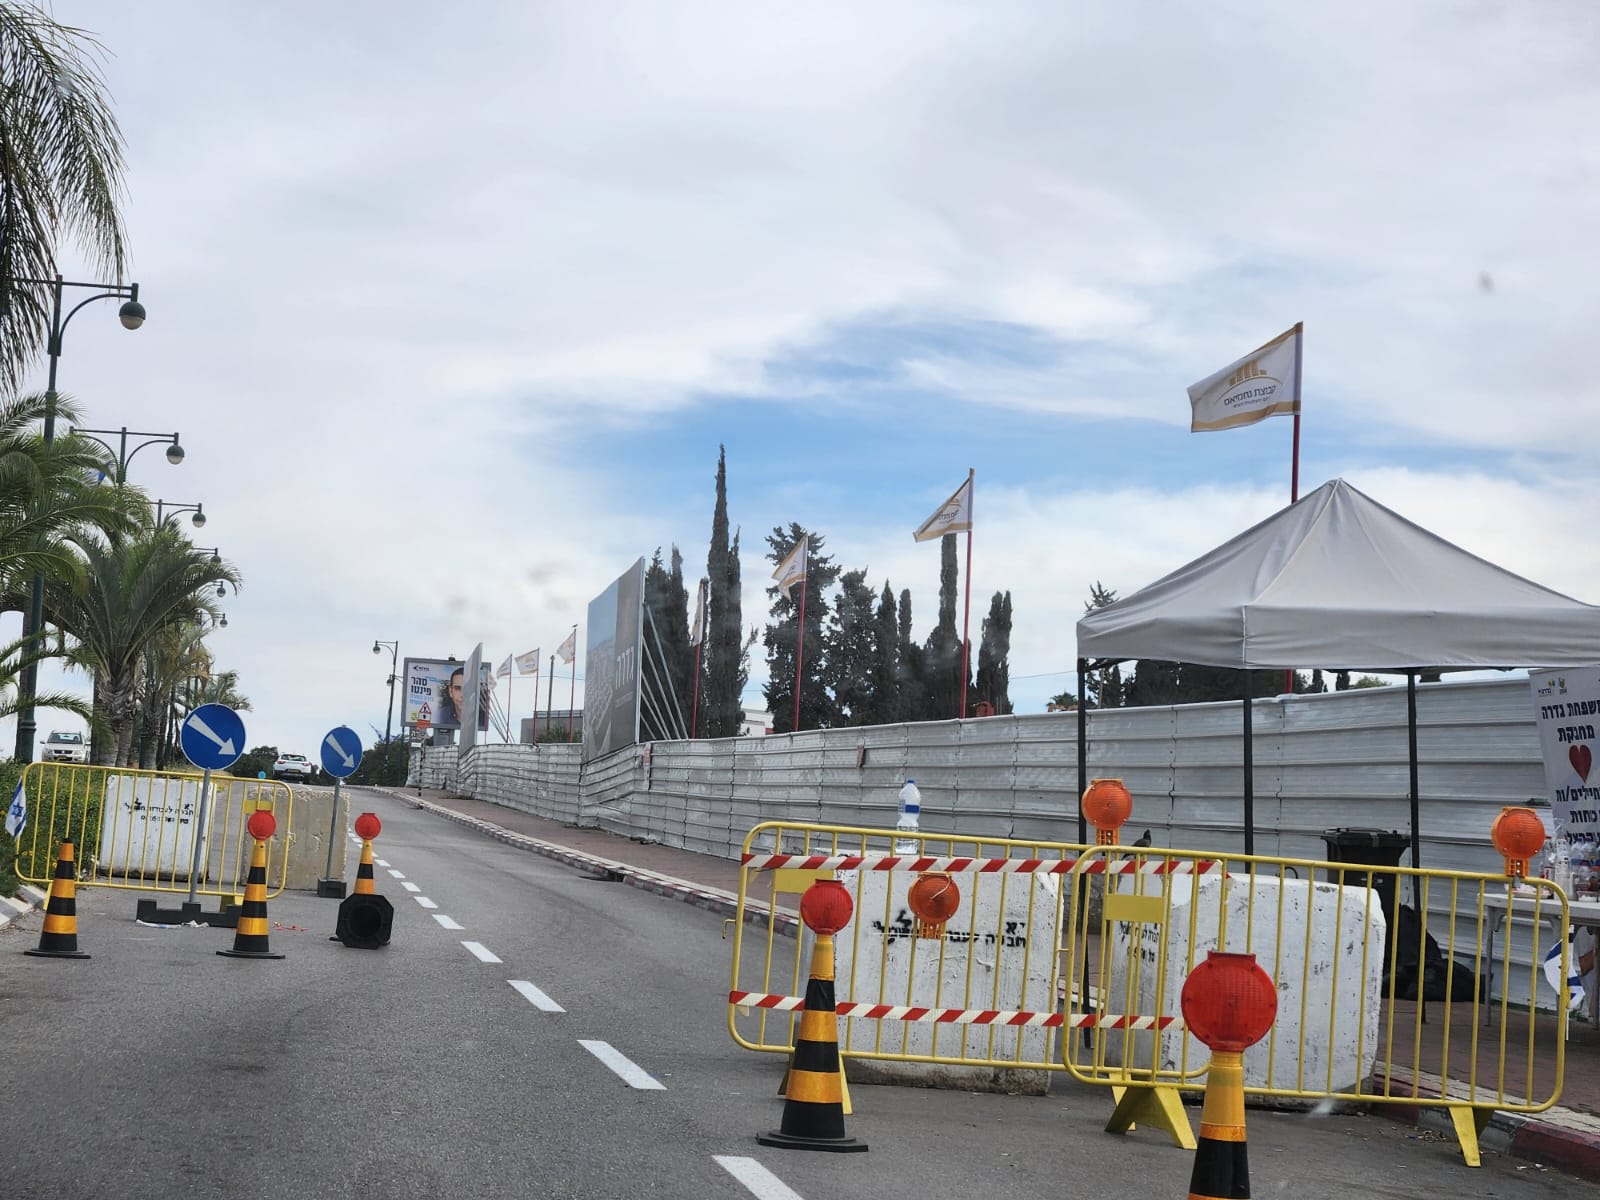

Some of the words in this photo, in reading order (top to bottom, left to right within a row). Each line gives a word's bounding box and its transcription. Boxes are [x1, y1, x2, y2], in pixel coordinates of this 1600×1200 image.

[1255, 385, 1276, 397] קבוצת
[1224, 390, 1253, 406] נחמיאס
[411, 677, 427, 686] סהר
[411, 685, 432, 695] פינטו
[1541, 704, 1566, 720] גדרה
